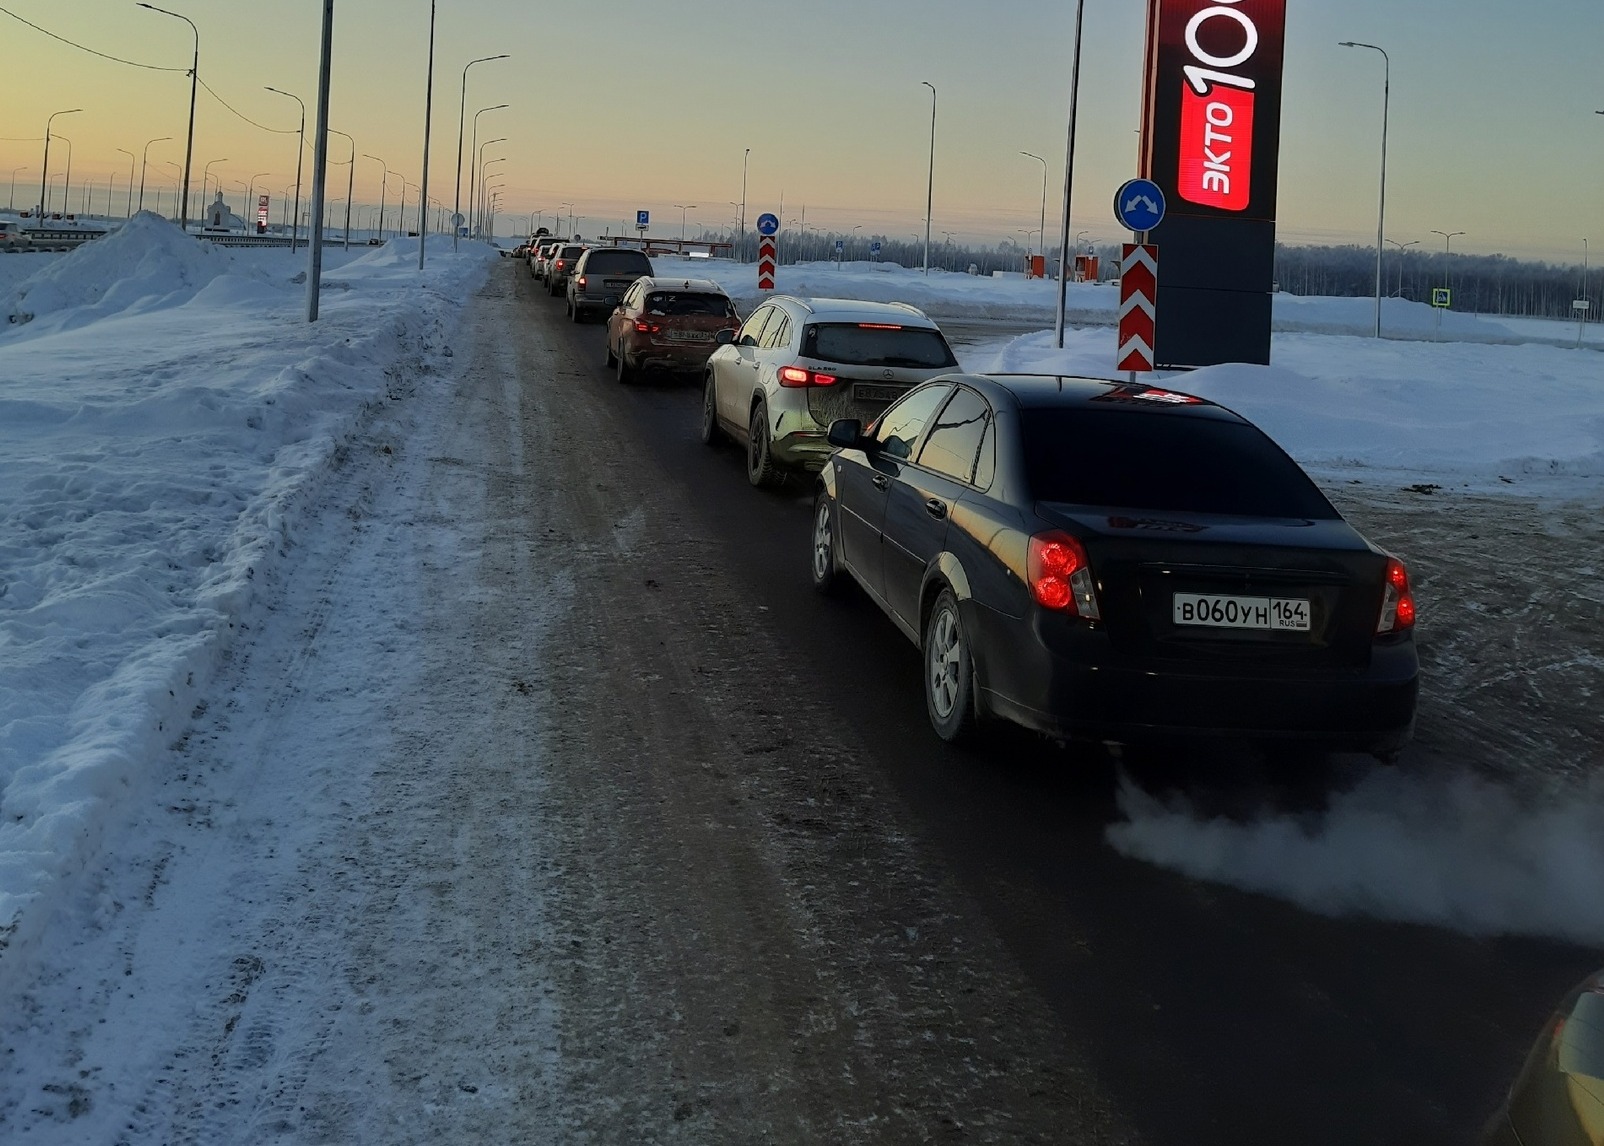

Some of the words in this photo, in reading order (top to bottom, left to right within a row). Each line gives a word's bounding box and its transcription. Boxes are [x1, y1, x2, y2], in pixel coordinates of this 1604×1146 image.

[1183, 0, 1258, 94] 10
[1202, 101, 1233, 194] ЭКТО
[1182, 598, 1268, 625] В060УН
[1272, 601, 1304, 620] 164
[1279, 620, 1295, 628] RUS
